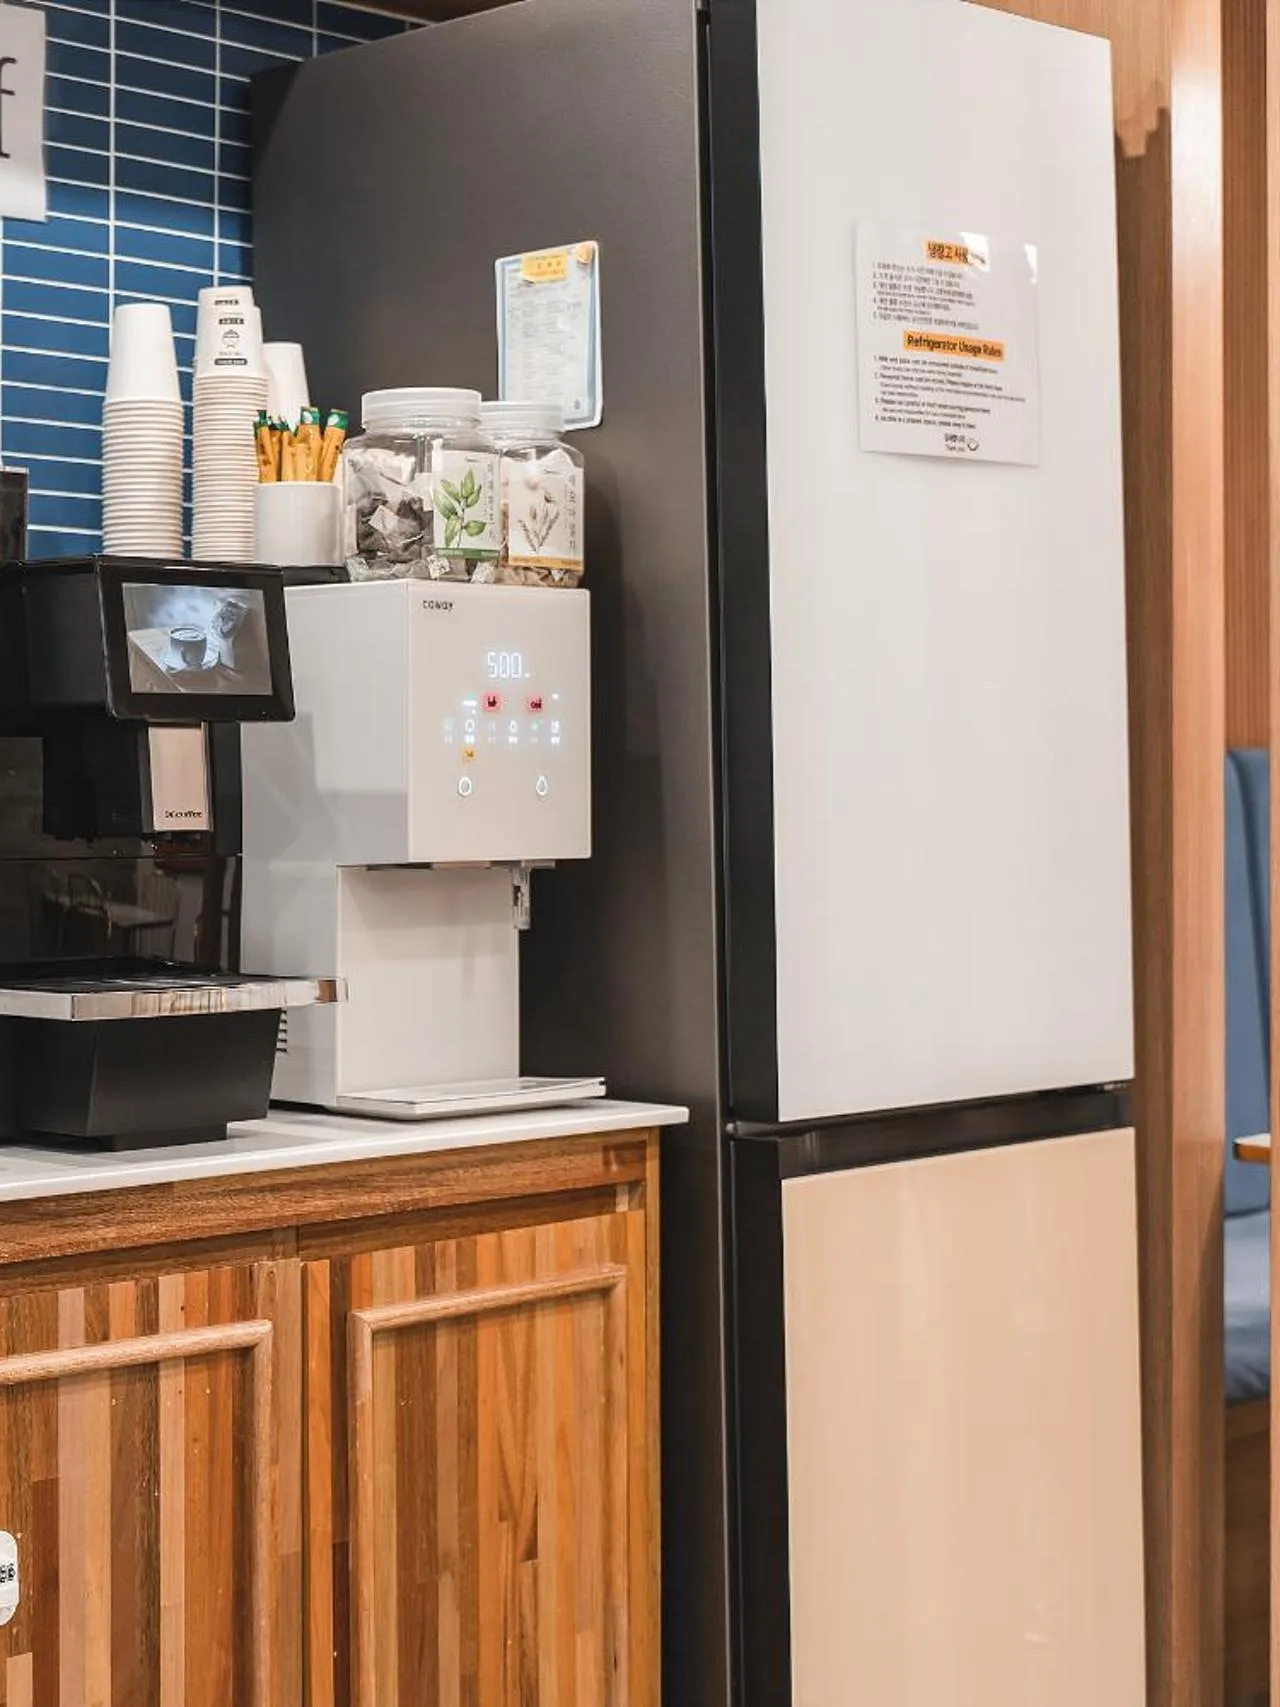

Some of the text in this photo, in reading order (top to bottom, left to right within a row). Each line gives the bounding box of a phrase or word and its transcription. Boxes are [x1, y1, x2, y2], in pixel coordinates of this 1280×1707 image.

[907, 334, 1004, 357] Refrigerator Usage Rules
